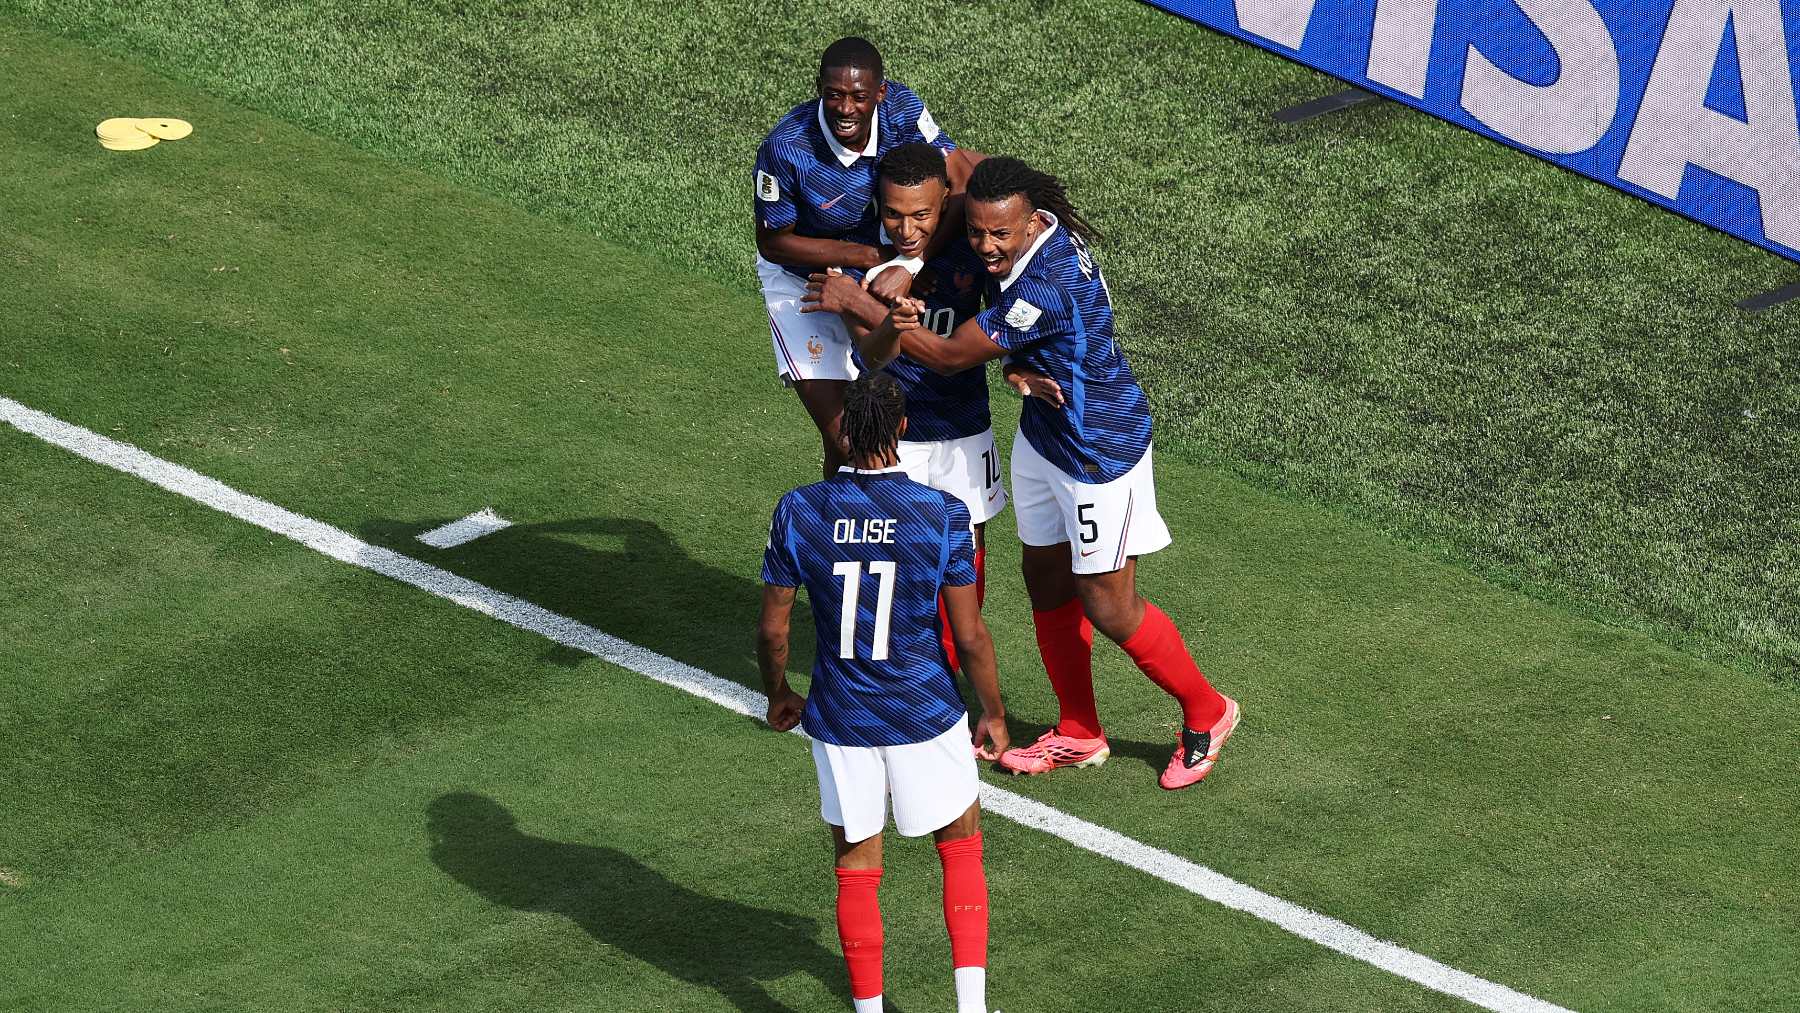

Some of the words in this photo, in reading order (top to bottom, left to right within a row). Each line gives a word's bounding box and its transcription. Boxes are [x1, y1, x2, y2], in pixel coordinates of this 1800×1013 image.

[1231, 0, 1800, 252] SA
[923, 307, 955, 339] 10
[981, 439, 1001, 489] 10
[833, 518, 897, 544] OLISE
[1077, 503, 1099, 544] 5
[832, 561, 897, 661] 11
